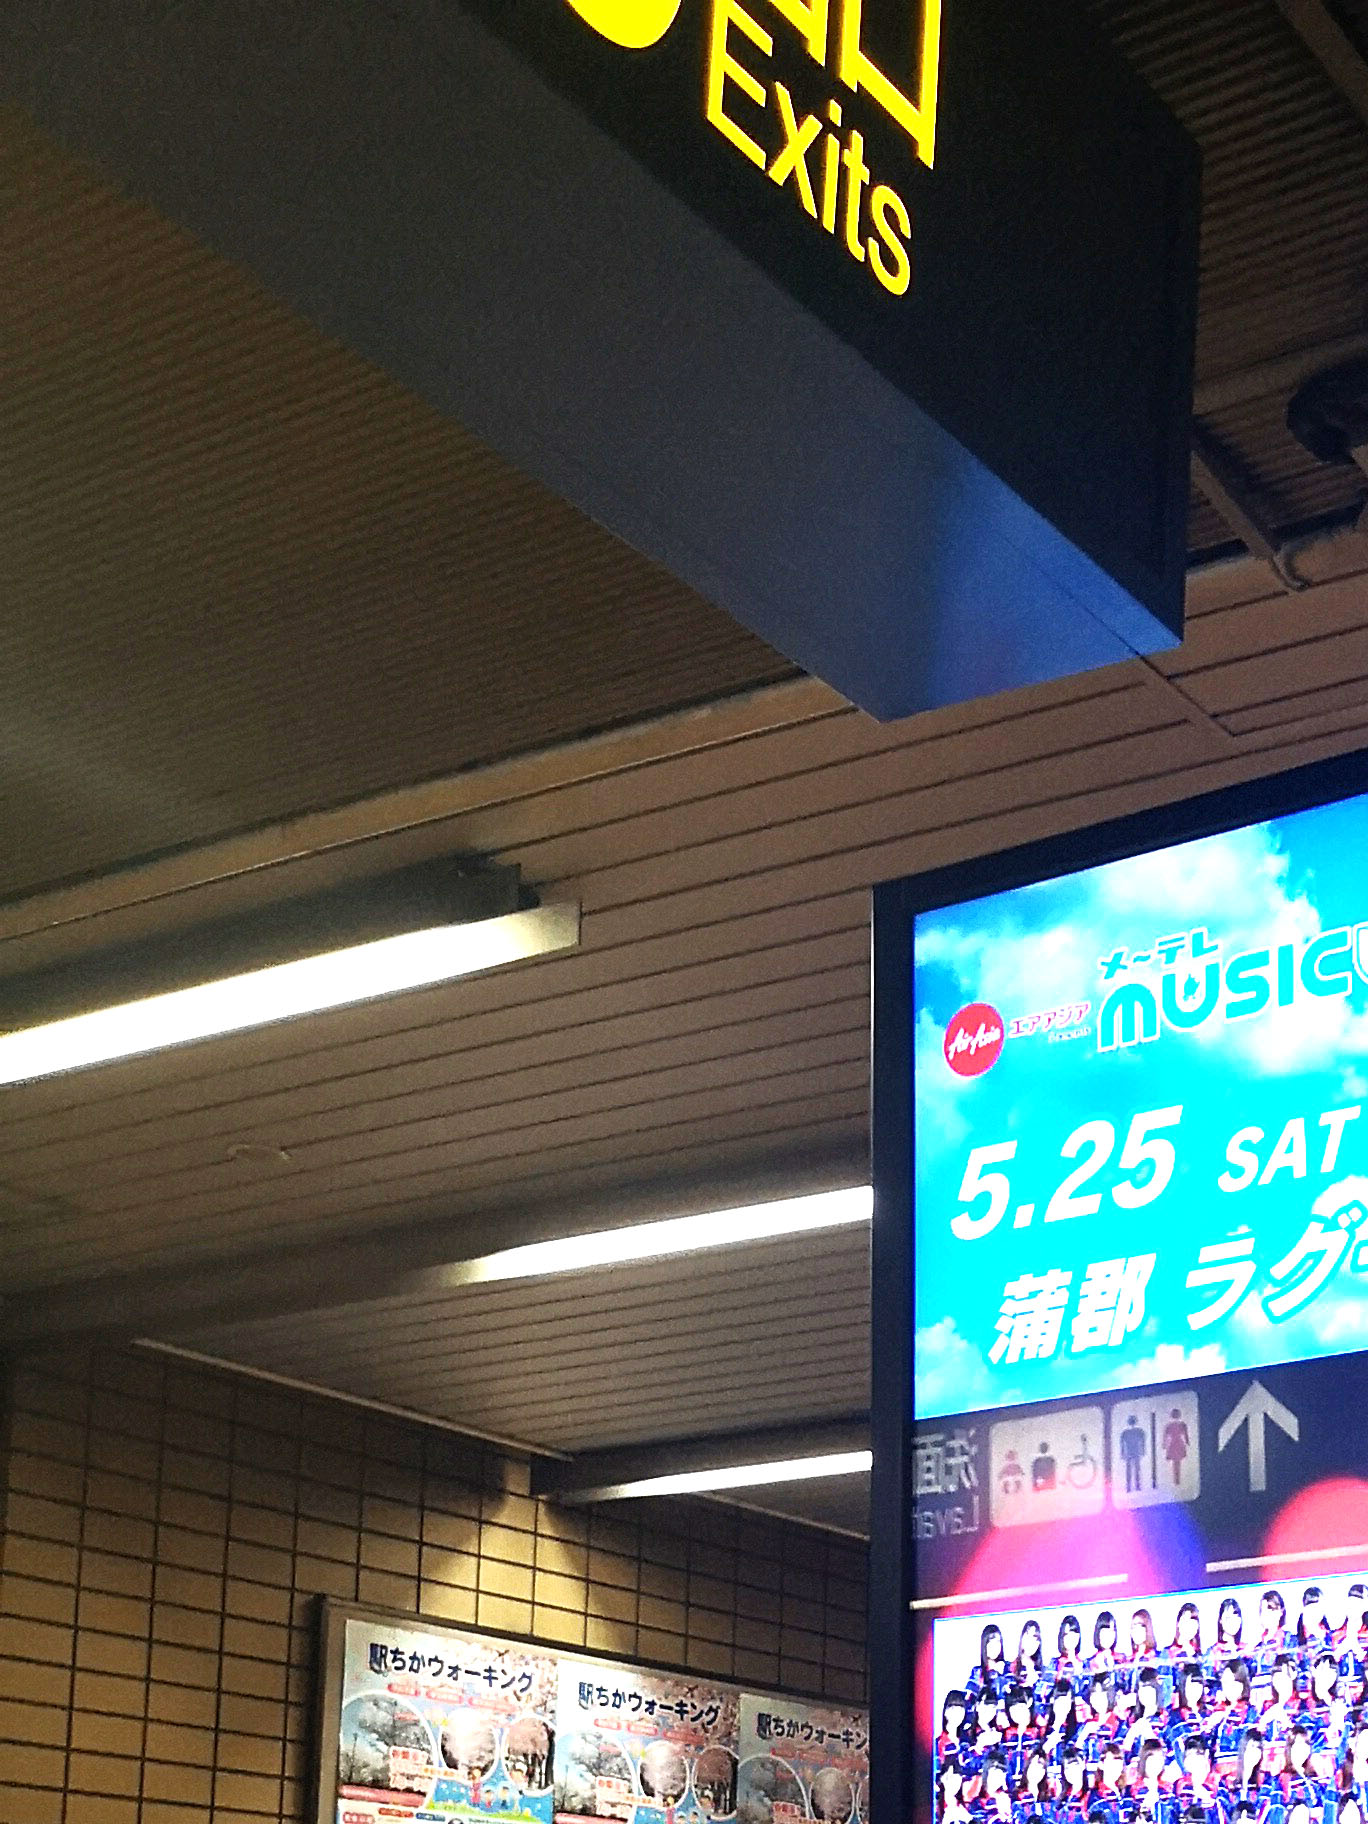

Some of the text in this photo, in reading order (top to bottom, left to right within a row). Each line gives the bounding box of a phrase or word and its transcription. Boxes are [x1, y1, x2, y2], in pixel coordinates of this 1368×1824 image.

[705, 0, 913, 296] Exits
[1009, 1001, 1091, 1038] エアアジア
[950, 1104, 1362, 1241] 5.25 SAT
[987, 1252, 1158, 1365] 蒲郡
[369, 1642, 534, 1694] 駅ちかウォーキング
[578, 1681, 721, 1727] 駅ちかウォーキング
